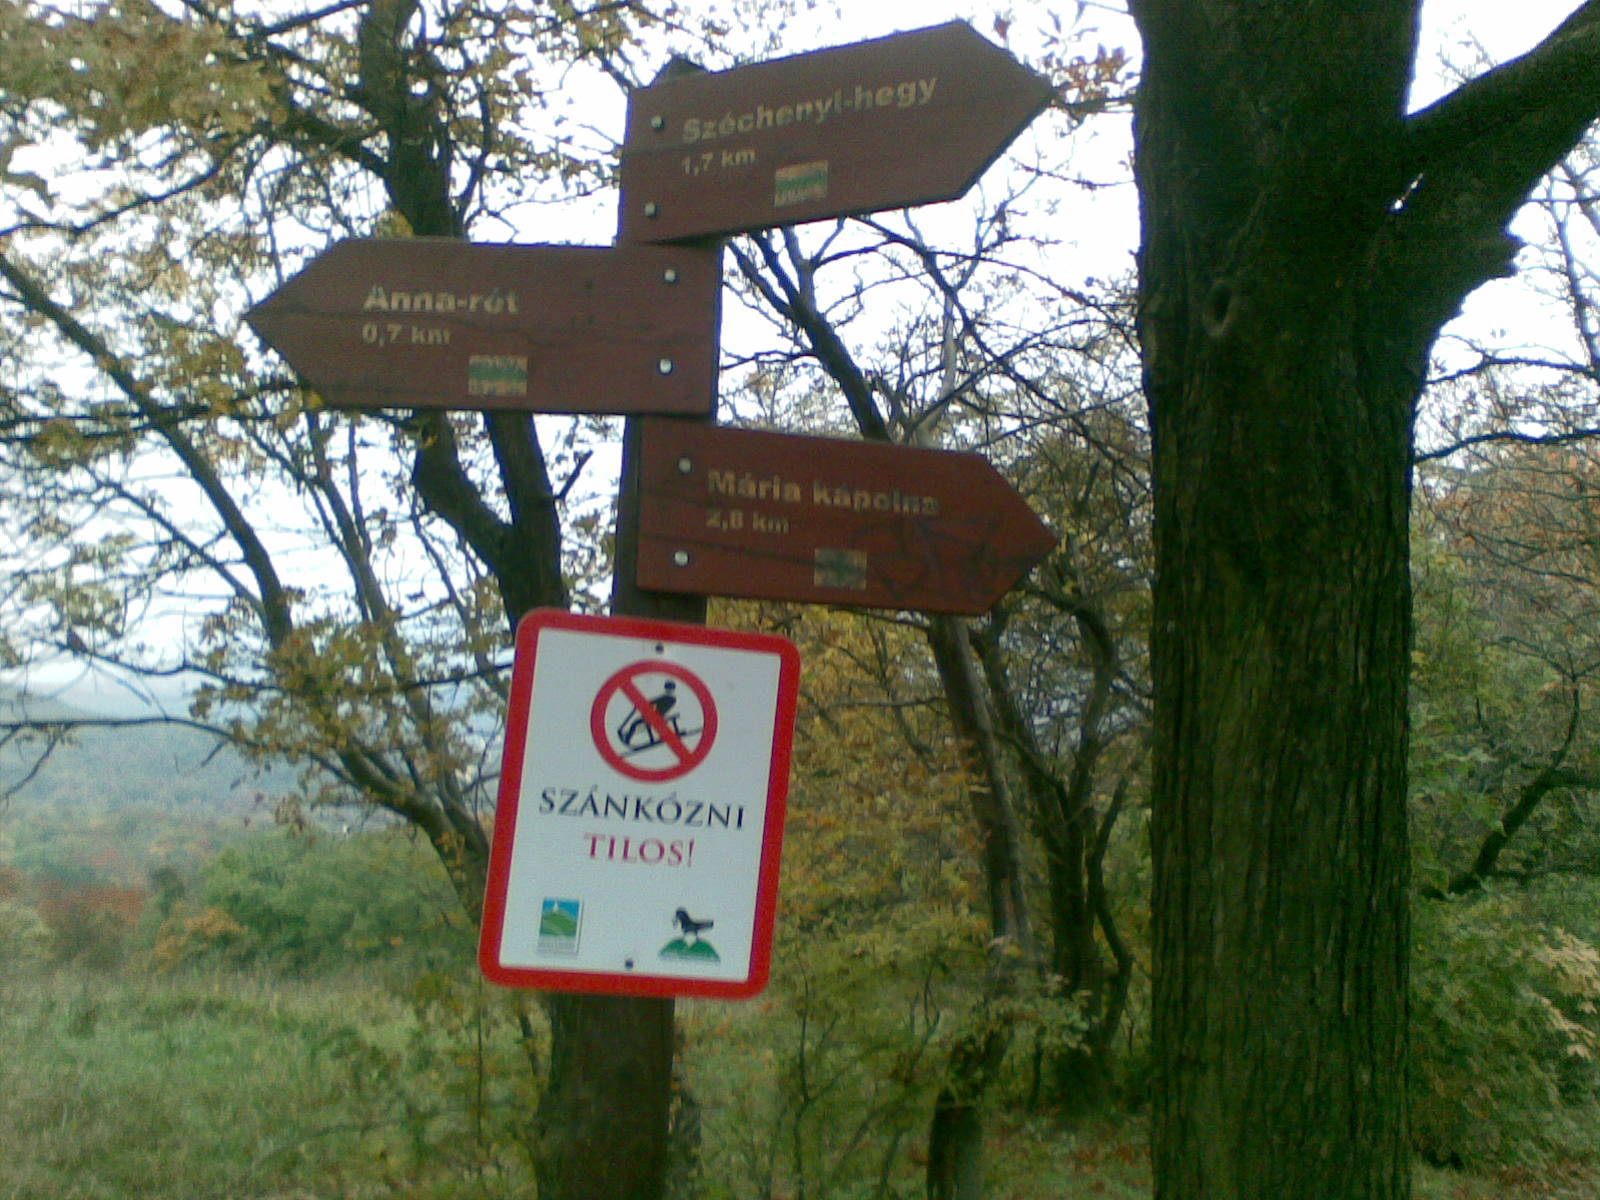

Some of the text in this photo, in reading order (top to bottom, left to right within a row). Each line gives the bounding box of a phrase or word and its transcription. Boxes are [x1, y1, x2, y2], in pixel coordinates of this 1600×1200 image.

[682, 149, 755, 176] 1,7 km
[362, 321, 450, 347] 0,7 km
[707, 469, 801, 503] Mária
[752, 512, 789, 535] km
[539, 784, 745, 831] SZÁNKÓZNI
[583, 831, 695, 868] TILOS!
